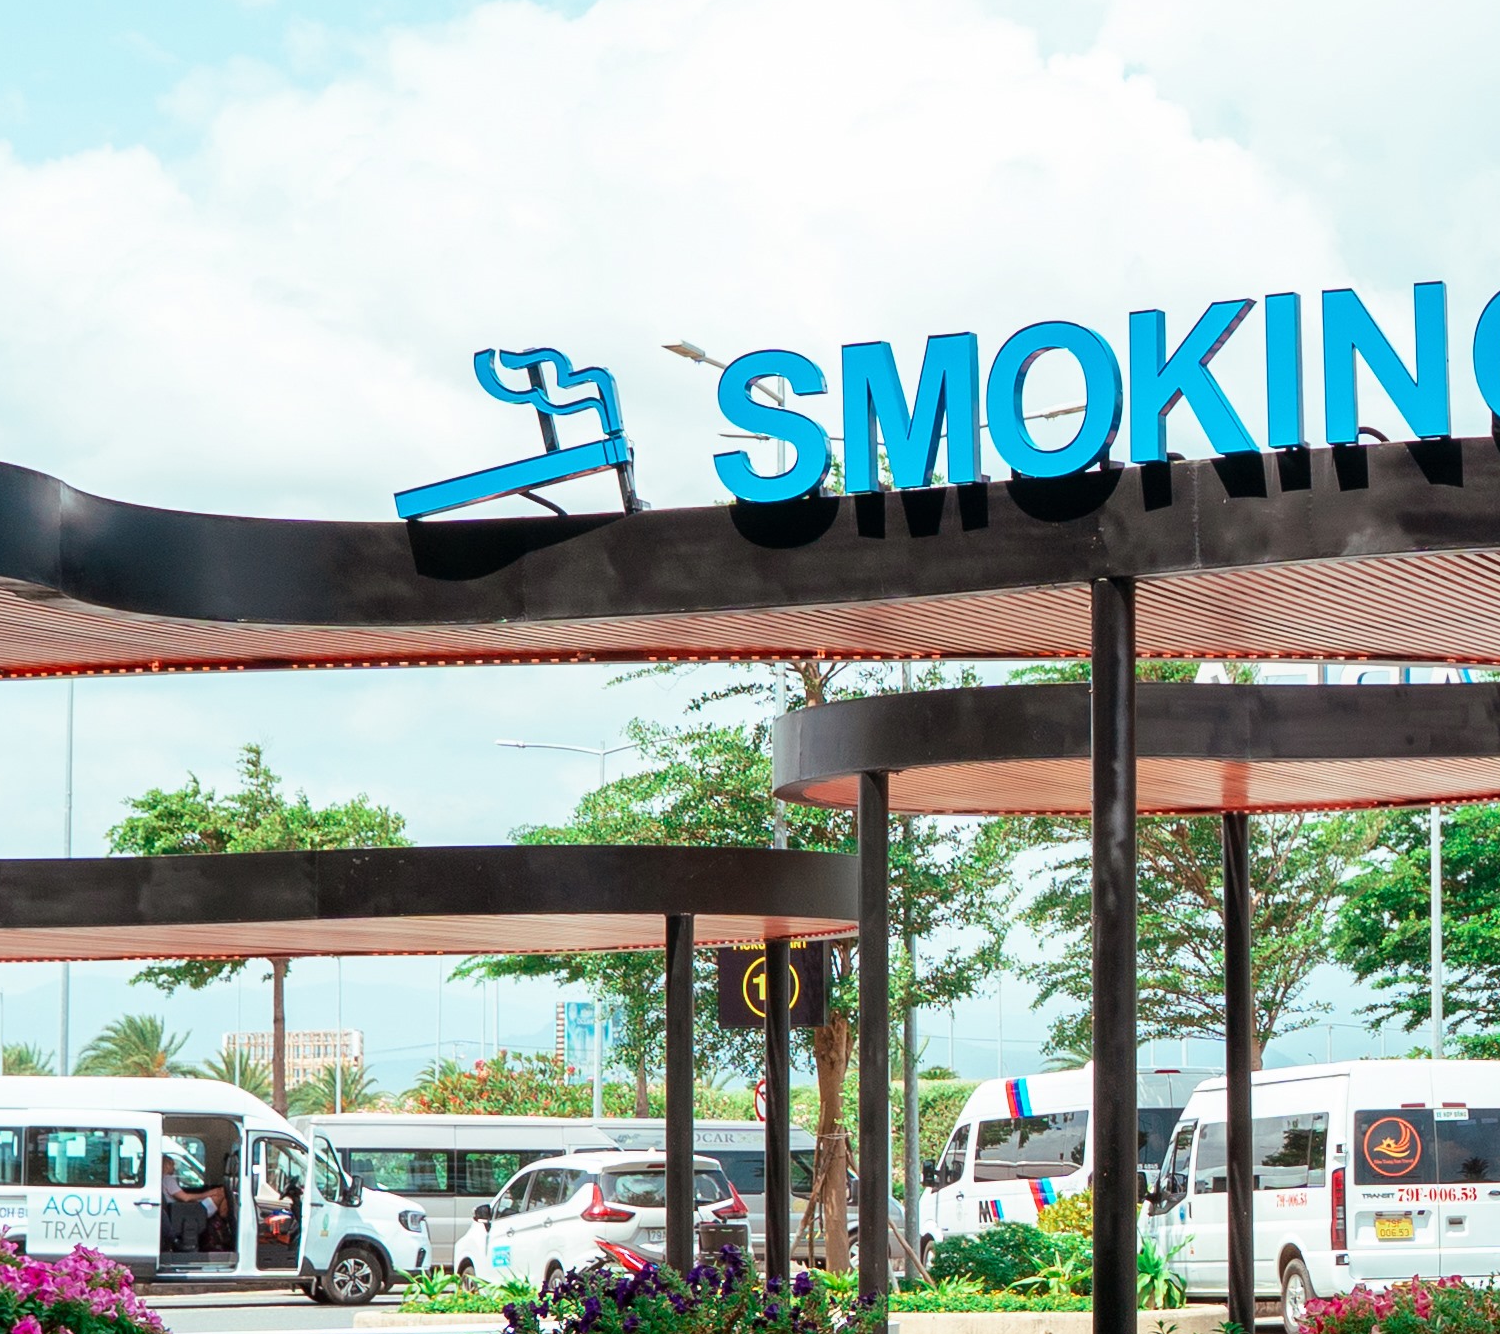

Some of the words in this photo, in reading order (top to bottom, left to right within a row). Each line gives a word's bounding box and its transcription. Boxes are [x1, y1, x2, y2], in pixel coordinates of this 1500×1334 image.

[1397, 1186, 1478, 1202] 79F-006.53
[42, 1194, 121, 1217] AQUA
[41, 1220, 120, 1240] TRAVEL
